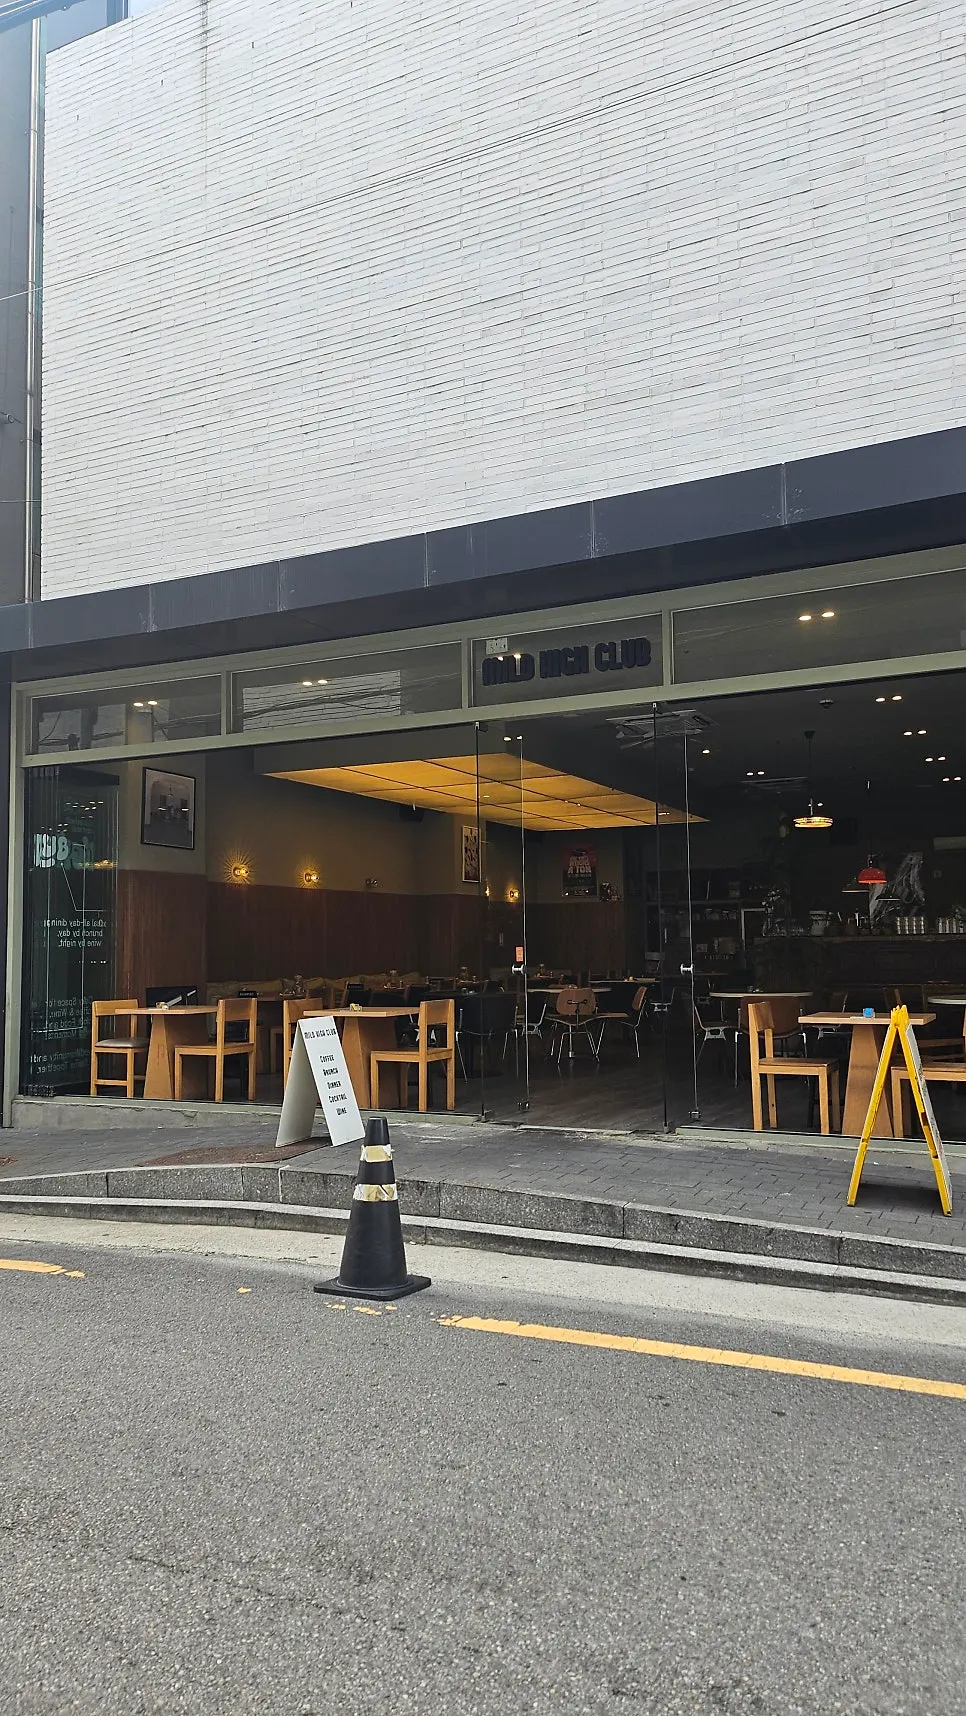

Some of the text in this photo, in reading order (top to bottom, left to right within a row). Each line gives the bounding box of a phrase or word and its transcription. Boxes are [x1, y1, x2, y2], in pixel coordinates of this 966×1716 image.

[482, 637, 652, 686] MILD HIGH CLUB
